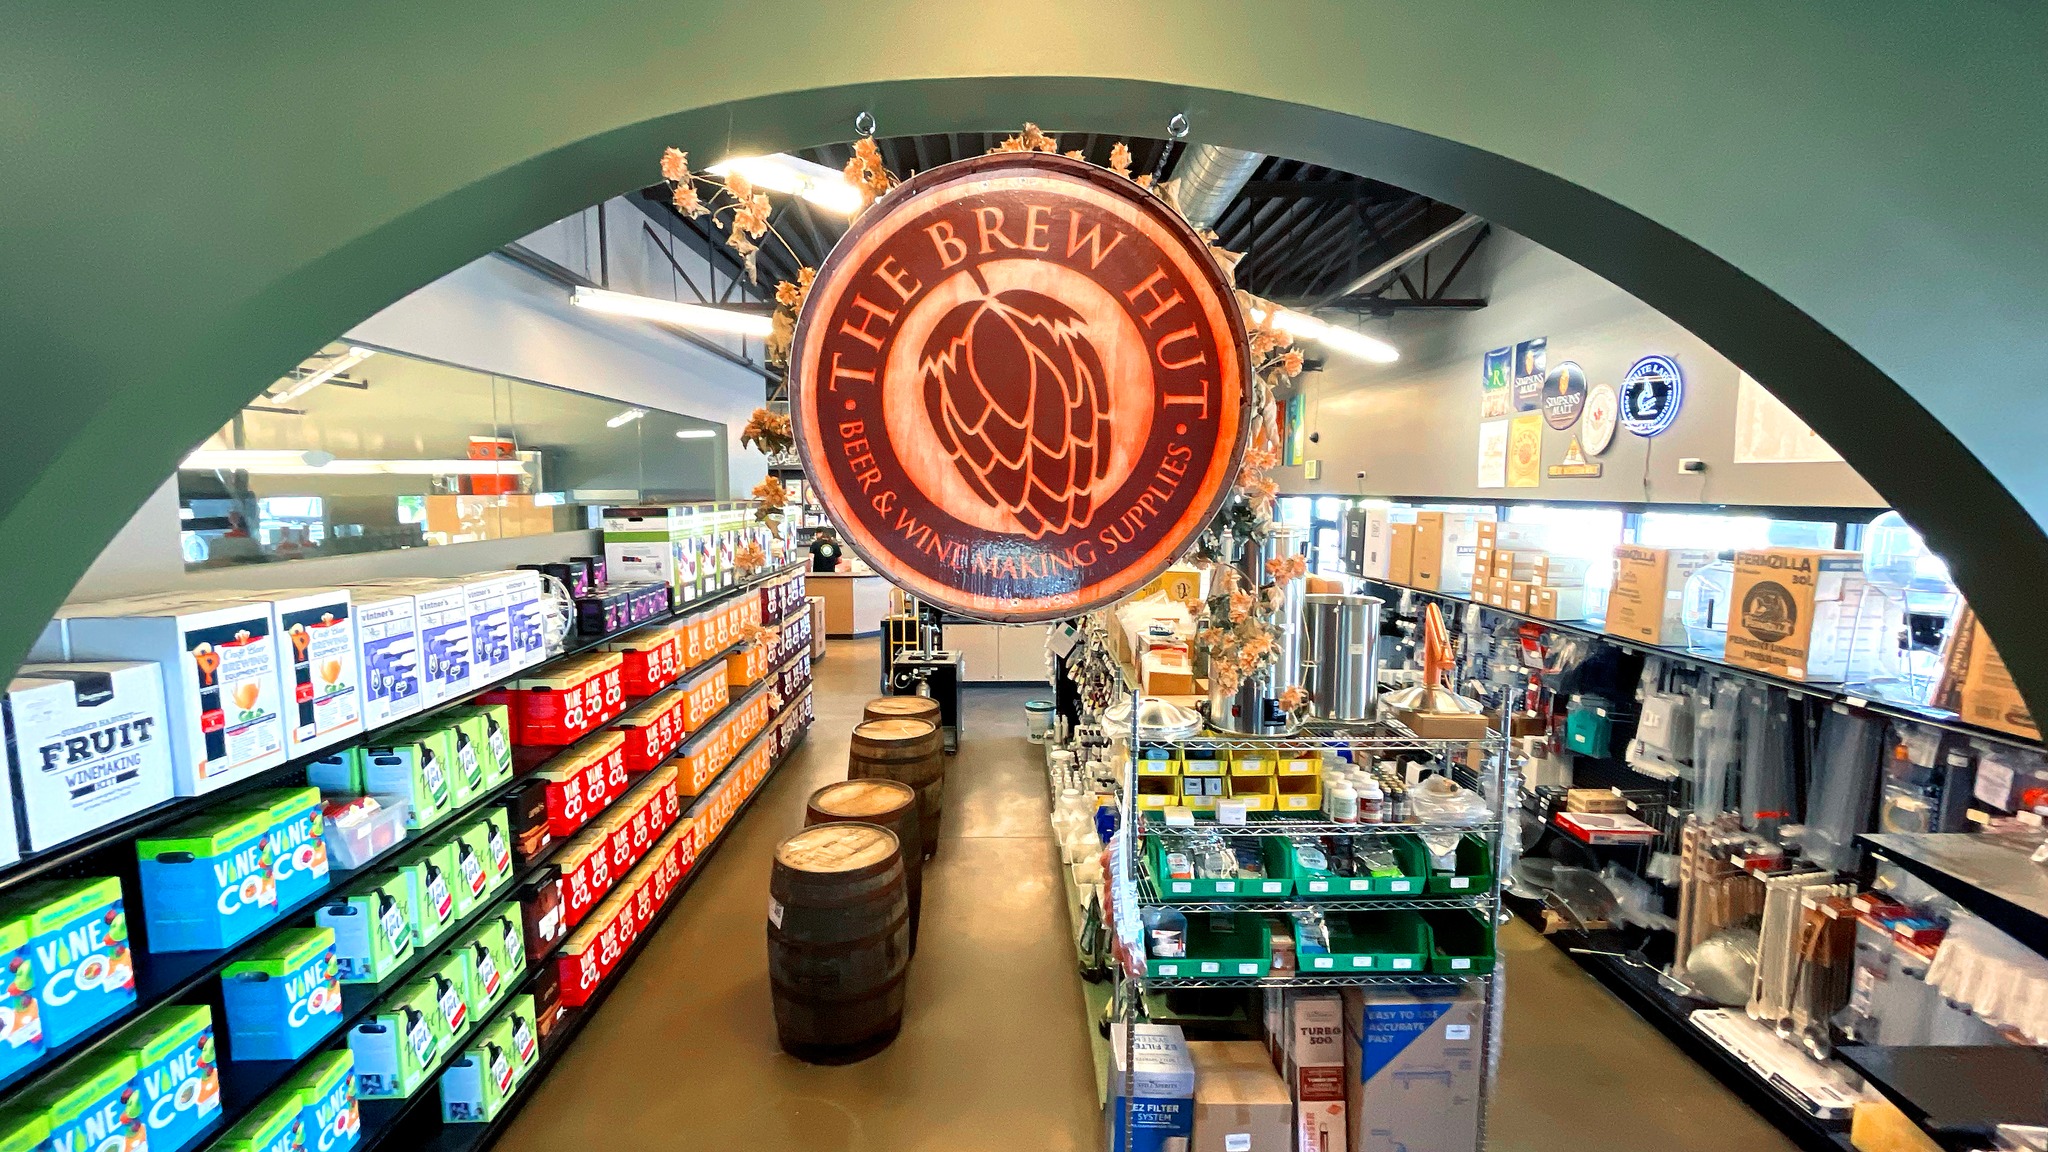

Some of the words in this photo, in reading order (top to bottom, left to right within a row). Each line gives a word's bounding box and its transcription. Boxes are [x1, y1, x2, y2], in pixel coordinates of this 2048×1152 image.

[829, 255, 923, 393] THE
[922, 205, 1128, 271] BREW
[1123, 265, 1208, 420] HUT
[1552, 405, 1573, 416] MALT
[839, 419, 882, 496] BEER
[871, 491, 899, 518] &
[973, 540, 1098, 580] MAKING
[1100, 442, 1193, 552] SUPPLIES
[1737, 552, 1811, 572] FERMZILLA
[39, 716, 155, 773] FRUIT
[65, 753, 141, 788] WINEMAKING
[270, 817, 311, 856] VINE
[214, 845, 261, 888] VINE
[272, 844, 315, 881] CO
[217, 874, 263, 915] CO
[36, 919, 105, 974] VINE
[42, 954, 110, 1006] CO
[285, 960, 326, 1004] VINE
[287, 986, 328, 1028] CO
[1301, 1027, 1341, 1036] TURBO
[1310, 1036, 1333, 1045] 500
[144, 1045, 197, 1101] VINE
[148, 1077, 201, 1129] CO
[315, 1081, 348, 1129] VINE
[1133, 1104, 1145, 1112] EZ
[1147, 1104, 1179, 1113] FILTER
[1138, 1113, 1172, 1122] SYSTEM
